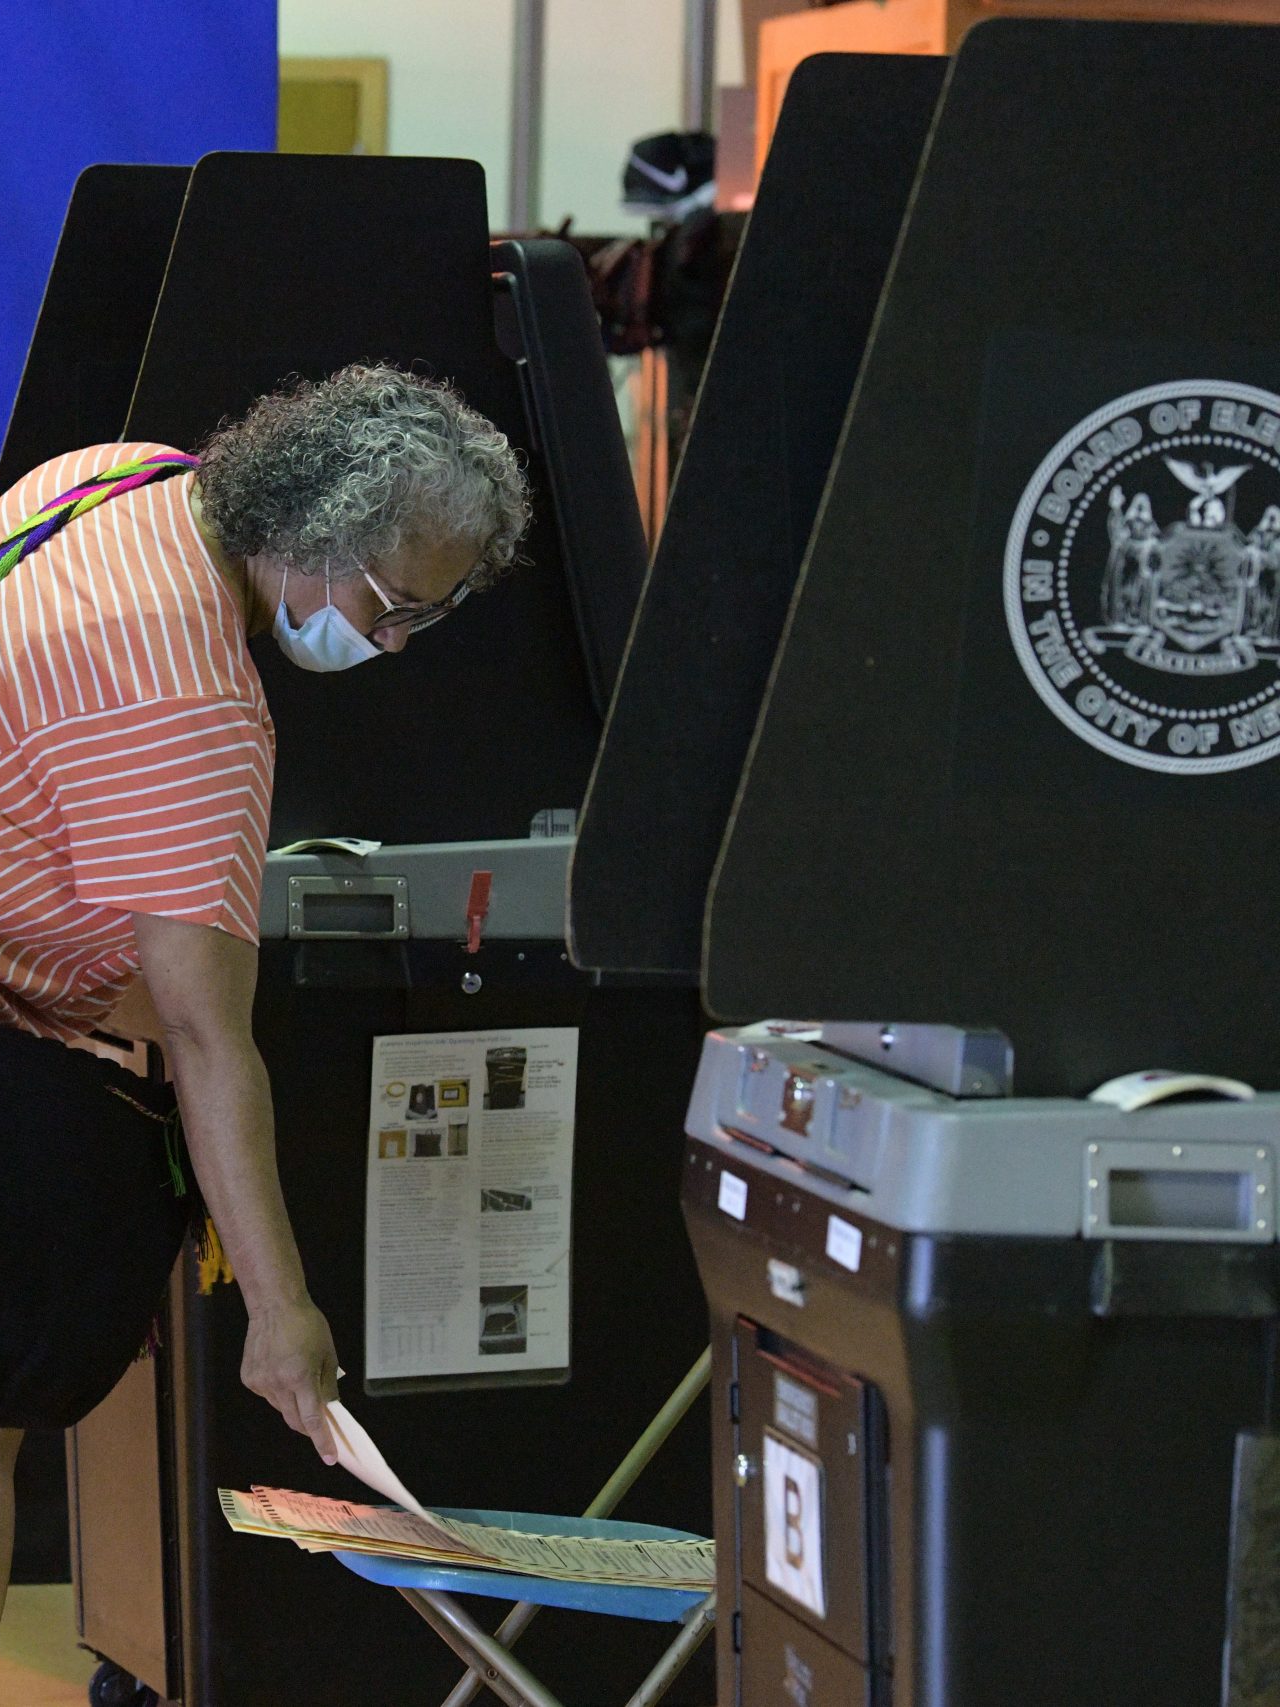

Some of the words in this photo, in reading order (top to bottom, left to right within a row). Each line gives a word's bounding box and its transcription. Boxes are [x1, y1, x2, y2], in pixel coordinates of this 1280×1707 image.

[1036, 416, 1143, 525] BOARD
[1149, 399, 1202, 436] OF
[1209, 399, 1280, 456] ELE
[1022, 558, 1054, 602] IN
[1028, 609, 1084, 689] THE
[1075, 684, 1163, 747] CITY
[1167, 722, 1220, 755] OF
[1228, 697, 1280, 748] NE
